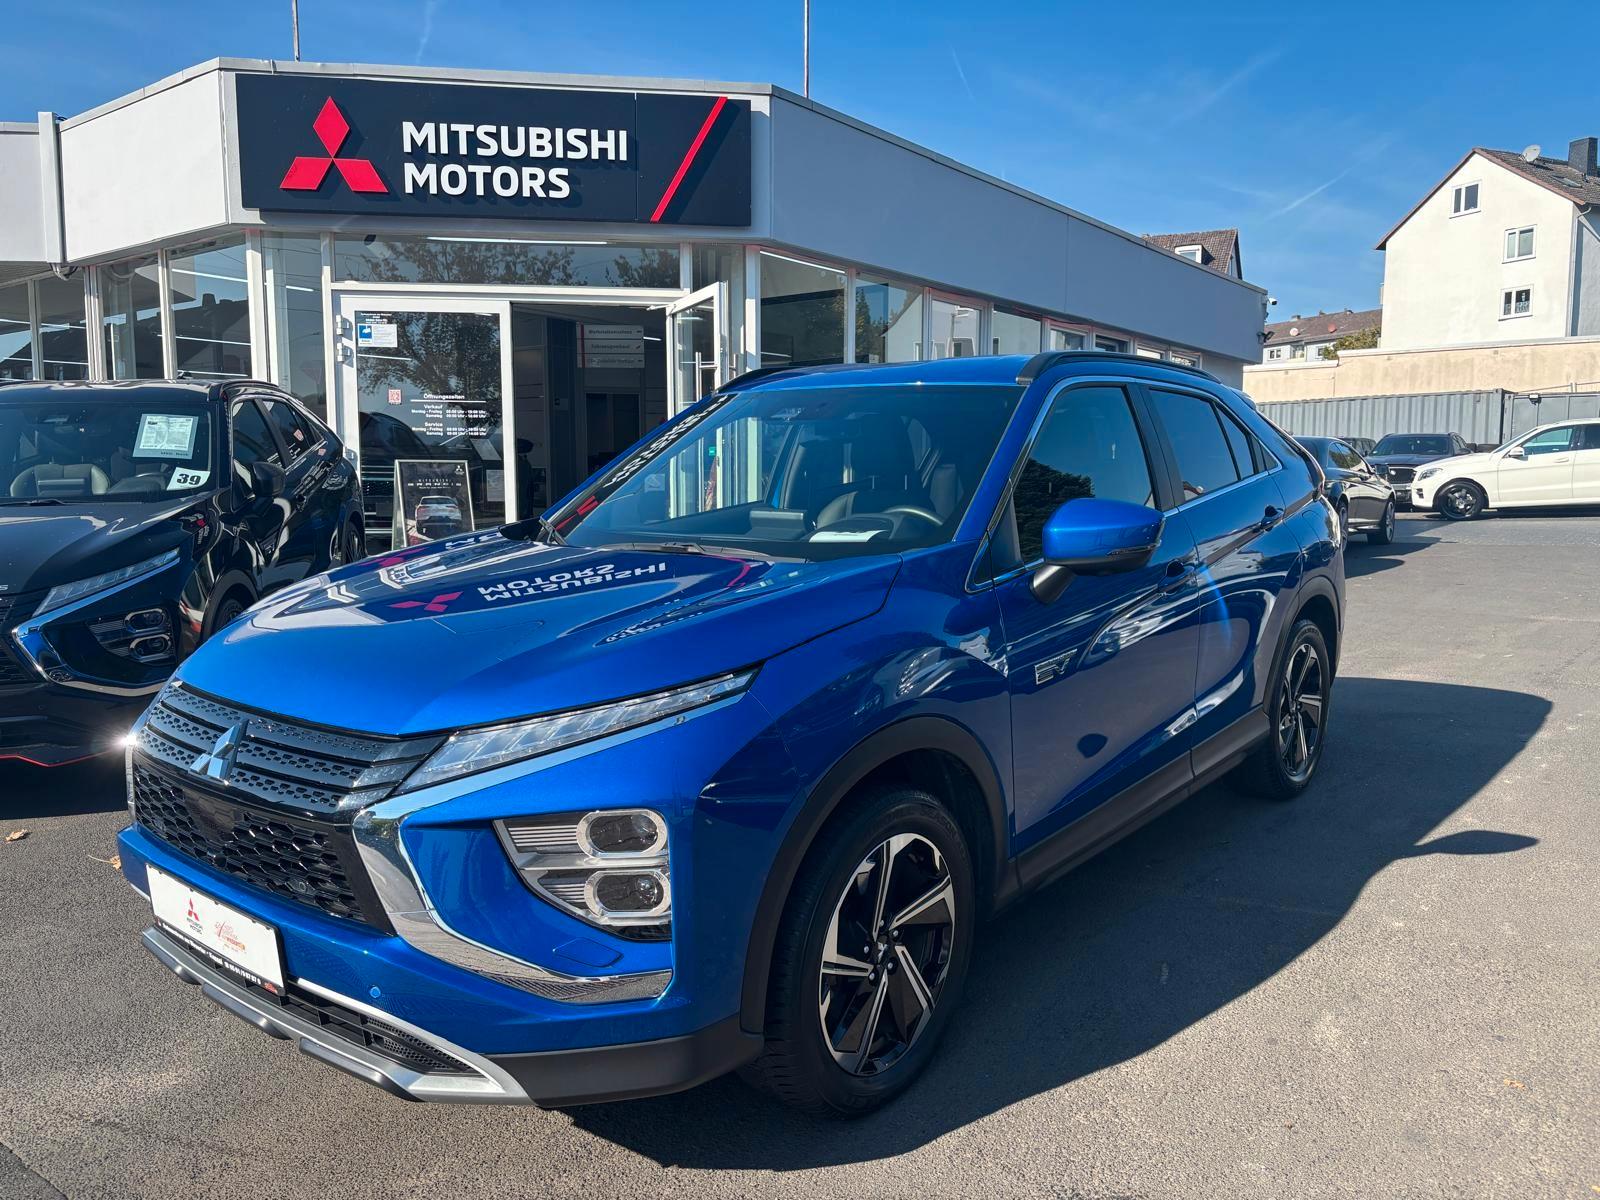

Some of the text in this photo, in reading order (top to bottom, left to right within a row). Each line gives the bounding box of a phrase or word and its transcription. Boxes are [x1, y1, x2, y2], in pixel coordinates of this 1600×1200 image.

[402, 121, 628, 162] MITSUBISHI
[404, 162, 571, 199] MOTORS
[176, 473, 202, 486] 39
